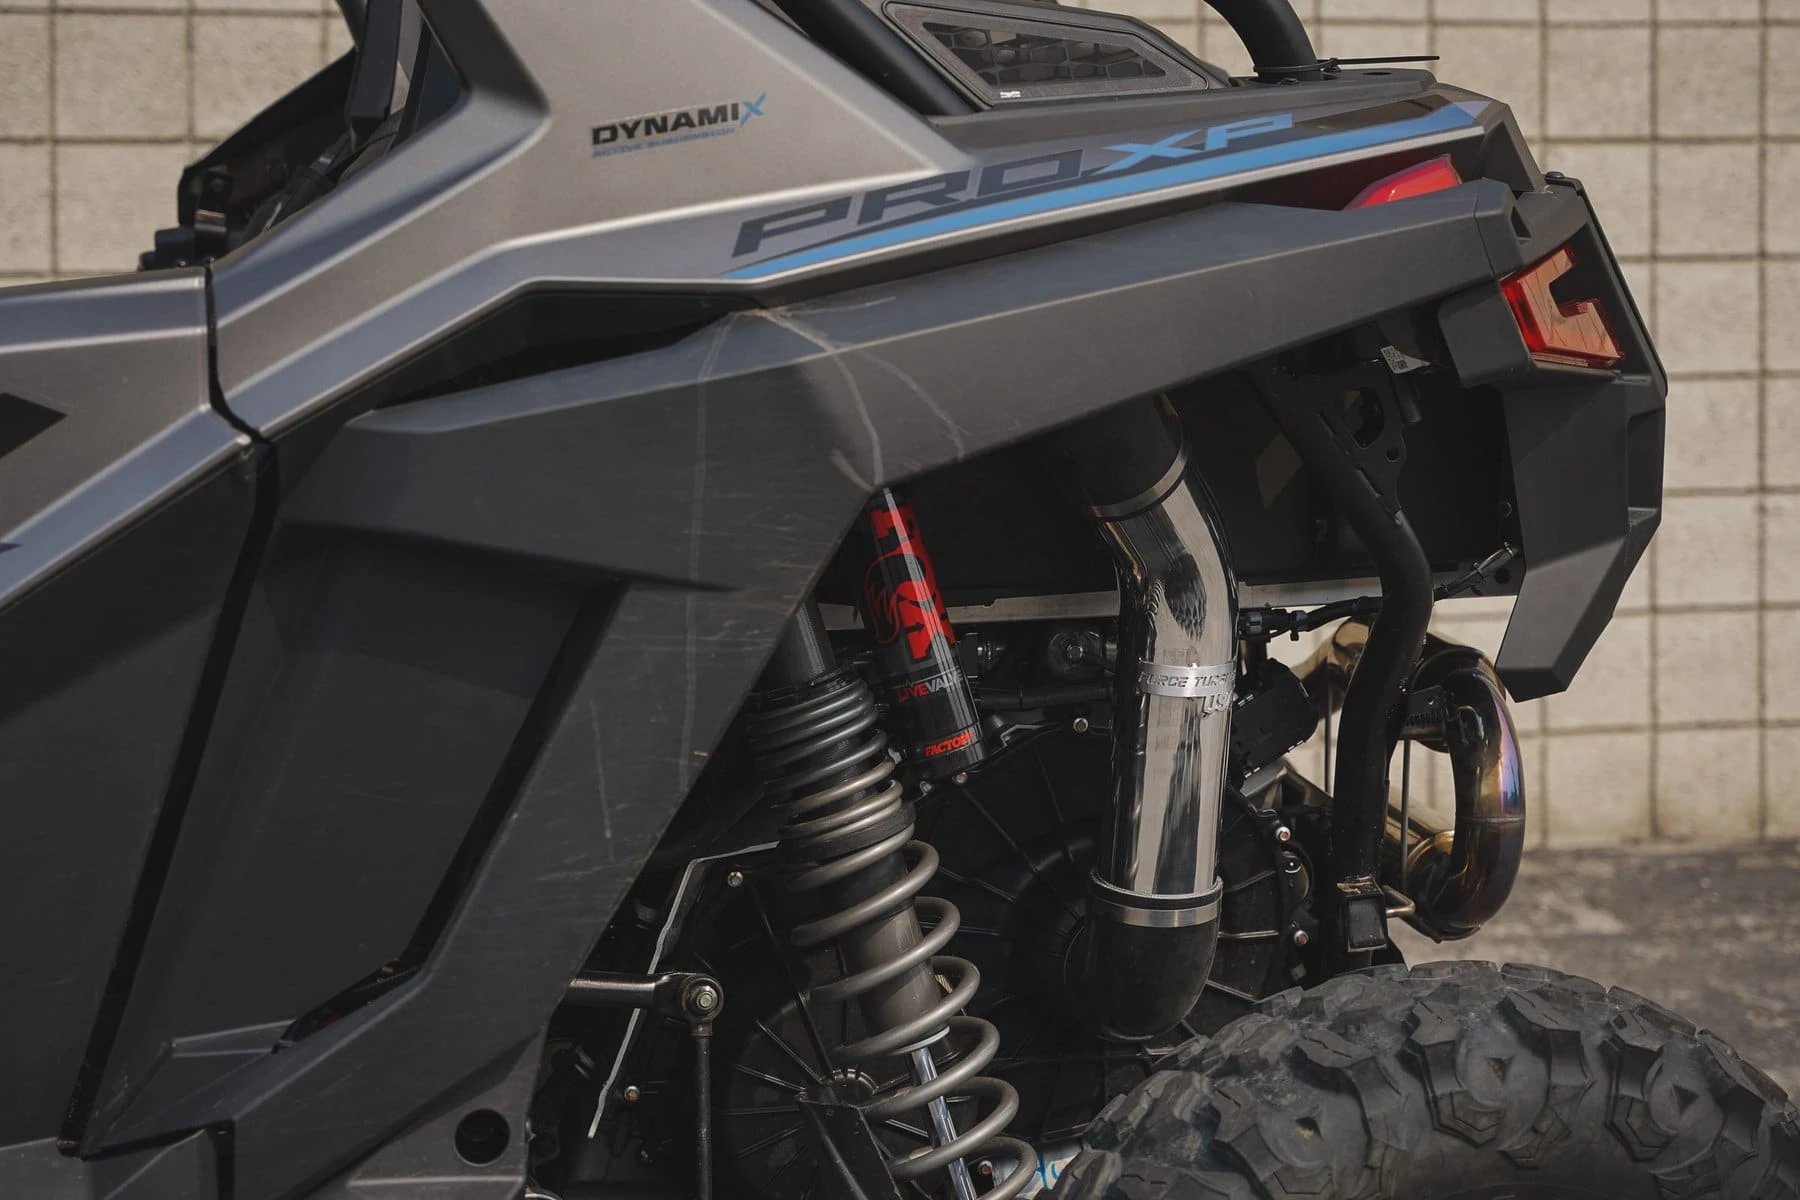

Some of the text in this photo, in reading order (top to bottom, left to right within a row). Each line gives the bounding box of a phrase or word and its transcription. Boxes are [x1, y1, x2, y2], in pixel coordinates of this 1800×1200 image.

[591, 91, 767, 146] DYNAMIX
[732, 112, 1293, 258] PRO XP
